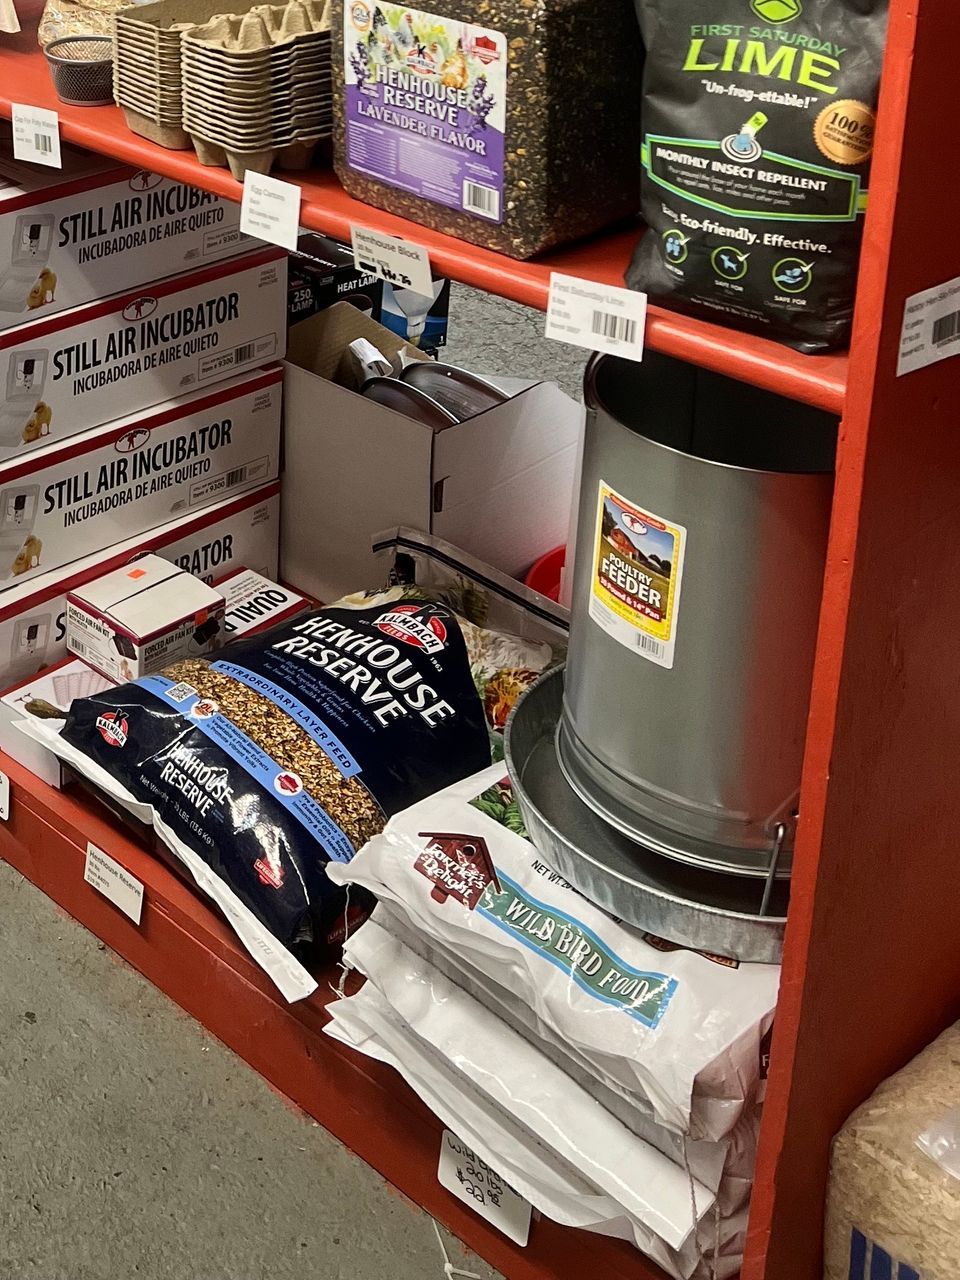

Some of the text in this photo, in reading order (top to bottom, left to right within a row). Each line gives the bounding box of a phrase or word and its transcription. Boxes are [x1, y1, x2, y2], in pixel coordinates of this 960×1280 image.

[691, 25, 847, 58] FIRST SATURDAY
[375, 64, 468, 109] HENHOUSE
[683, 39, 841, 95] LIME
[383, 86, 458, 127] RESERVE
[358, 101, 487, 157] LAVENDER FLAVOR
[656, 147, 710, 169] MONTHLY
[712, 161, 755, 180] INSECT
[757, 171, 827, 192] REPELLENT
[58, 199, 142, 248] STILL AIR
[78, 207, 224, 264] INCUBADORA DE AIRE QUIETO
[223, 233, 239, 243] 9300
[680, 212, 833, 254] Eco-friendly. Effective.
[356, 231, 421, 261] Henhouse Block
[337, 274, 380, 294] HEAT LAMP
[774, 295, 791, 304] SAFE
[291, 299, 314, 313] LAMP
[52, 293, 240, 380] STILL AIR INCUBATOR
[73, 332, 219, 396] INCUBADORA DE AIRE QUIETO
[218, 356, 234, 367] 9300
[43, 419, 233, 515] STILL AIR INCUBATOR
[209, 480, 226, 493] 9300
[64, 458, 211, 528] INCUBADORA DE AIRE QUIETO
[602, 558, 662, 608] FEEDER
[609, 552, 653, 587] POULTRY
[69, 607, 85, 622] FORCED
[234, 588, 289, 632] QUAIL
[607, 582, 660, 620] Pound Pan
[144, 626, 196, 656] FORCED AIR FAN KIT
[375, 613, 445, 654] KALMBACH
[383, 625, 408, 641] FEEDS
[272, 636, 408, 727] RESERVE
[292, 616, 456, 728] HENHOUSE
[96, 716, 128, 748] KALMBACH
[218, 663, 352, 769] EXTRAORDINARY LAYER FEED
[160, 761, 216, 818] RESERVE
[168, 741, 234, 805] HENHOUSE
[291, 801, 327, 839] Immunity Gut
[301, 803, 332, 836] Essential Oils
[314, 808, 338, 834] Probiotics
[89, 850, 119, 878] Henhouse
[119, 872, 141, 897] Reserve
[424, 859, 474, 900] Delight
[531, 859, 549, 876] NET
[505, 897, 650, 1004] WILD BIRD FOOD
